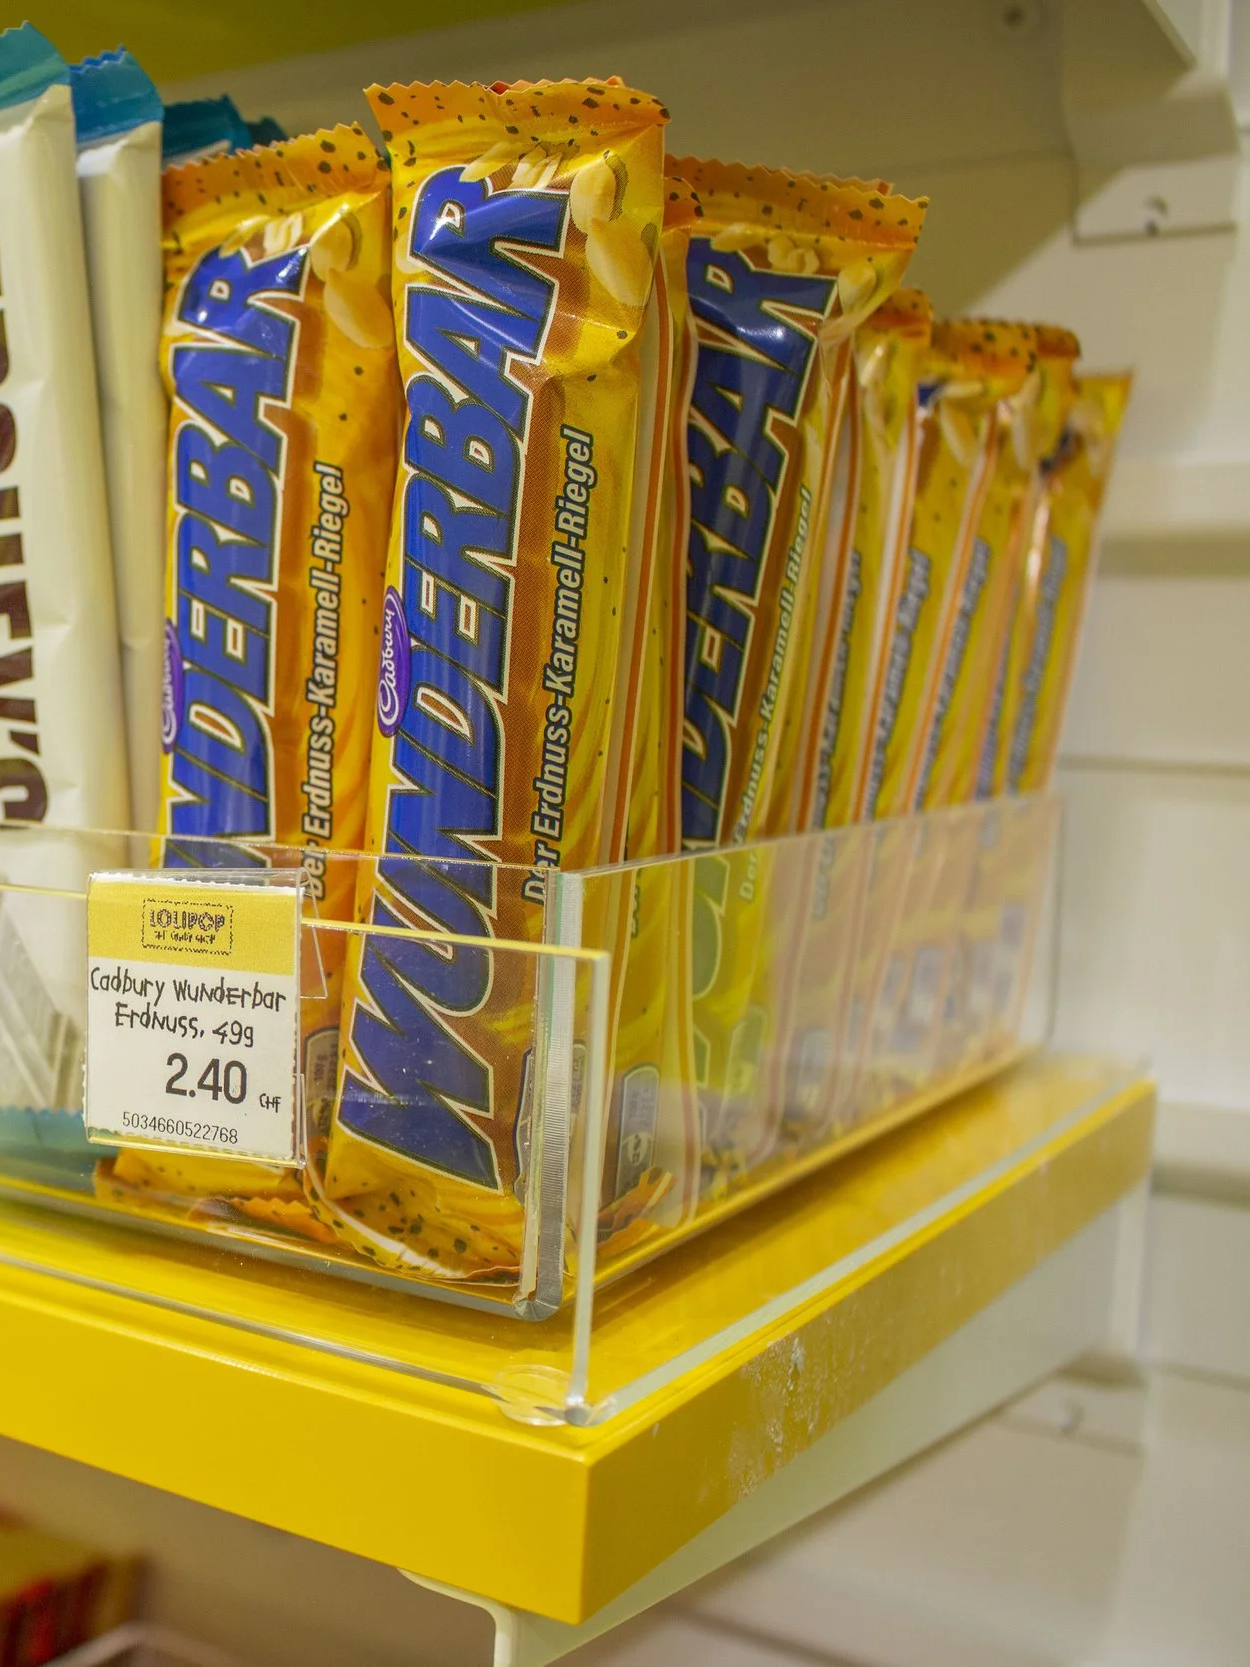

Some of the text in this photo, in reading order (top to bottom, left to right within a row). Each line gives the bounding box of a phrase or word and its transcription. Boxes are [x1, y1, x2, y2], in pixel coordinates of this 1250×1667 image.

[303, 461, 351, 839] Erdnuss-Karamell-Riegel
[531, 425, 597, 841] Erdnuss-Karamell-Riegel
[337, 164, 570, 1194] WUNDERBAR
[378, 607, 400, 728] Cadbury
[150, 908, 225, 933] LOLIPOP
[91, 966, 165, 1007] Cadbury
[212, 1020, 254, 1047] 49g
[166, 1052, 282, 1113] 2.40 CHF
[122, 1111, 239, 1144] 5034660522768
